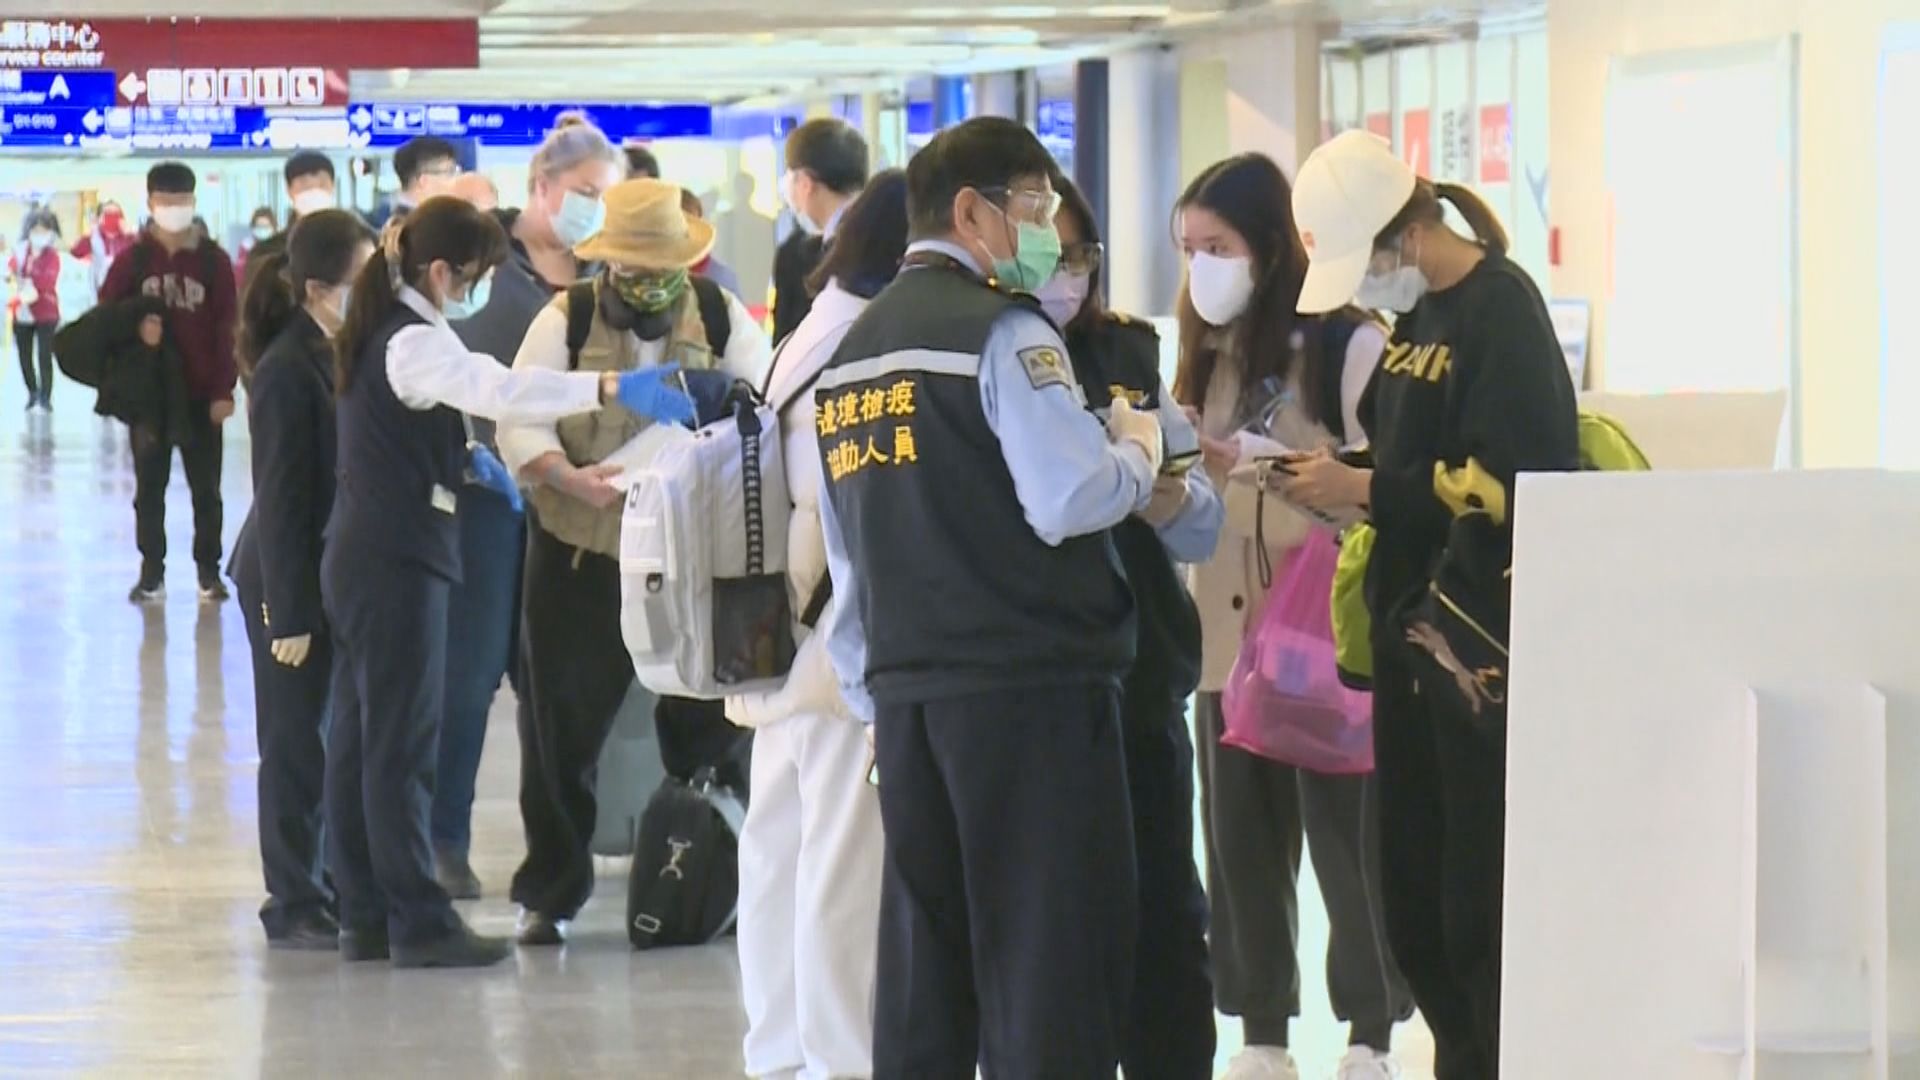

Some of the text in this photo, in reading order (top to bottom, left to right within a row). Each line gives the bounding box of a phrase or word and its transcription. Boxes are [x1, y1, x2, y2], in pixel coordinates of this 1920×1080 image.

[42, 50, 104, 66] counter
[48, 74, 71, 100] A
[142, 274, 205, 311] GAP
[816, 379, 916, 437] 邊境檢疫
